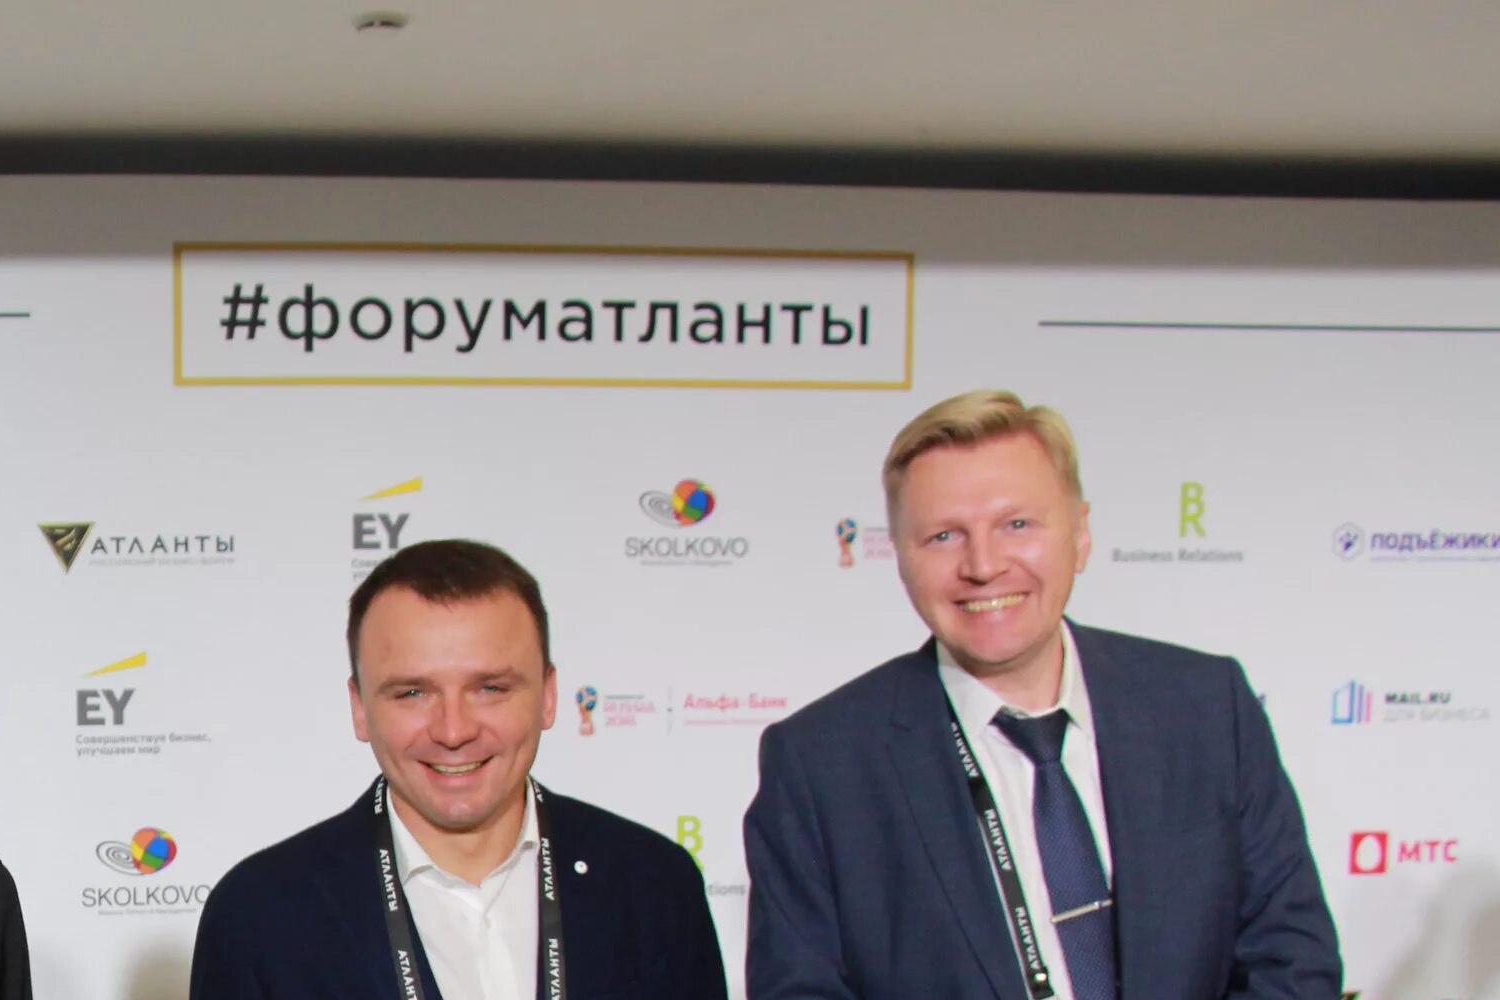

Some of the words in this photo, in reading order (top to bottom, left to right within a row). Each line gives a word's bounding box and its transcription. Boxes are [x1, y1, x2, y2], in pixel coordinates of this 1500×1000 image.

[219, 283, 871, 353] #форуматланты
[90, 535, 235, 555] АТЛАНТЫ
[352, 512, 410, 550] EY
[624, 537, 749, 558] SKOLKOVO
[76, 688, 135, 726] EY
[983, 808, 1012, 872] АТЛАНТЫ
[1397, 839, 1458, 863] МТС
[379, 848, 399, 912] АТЛАНТЫ
[541, 837, 556, 901] АТЛАНТЫ
[82, 884, 212, 907] SKOLKOVO
